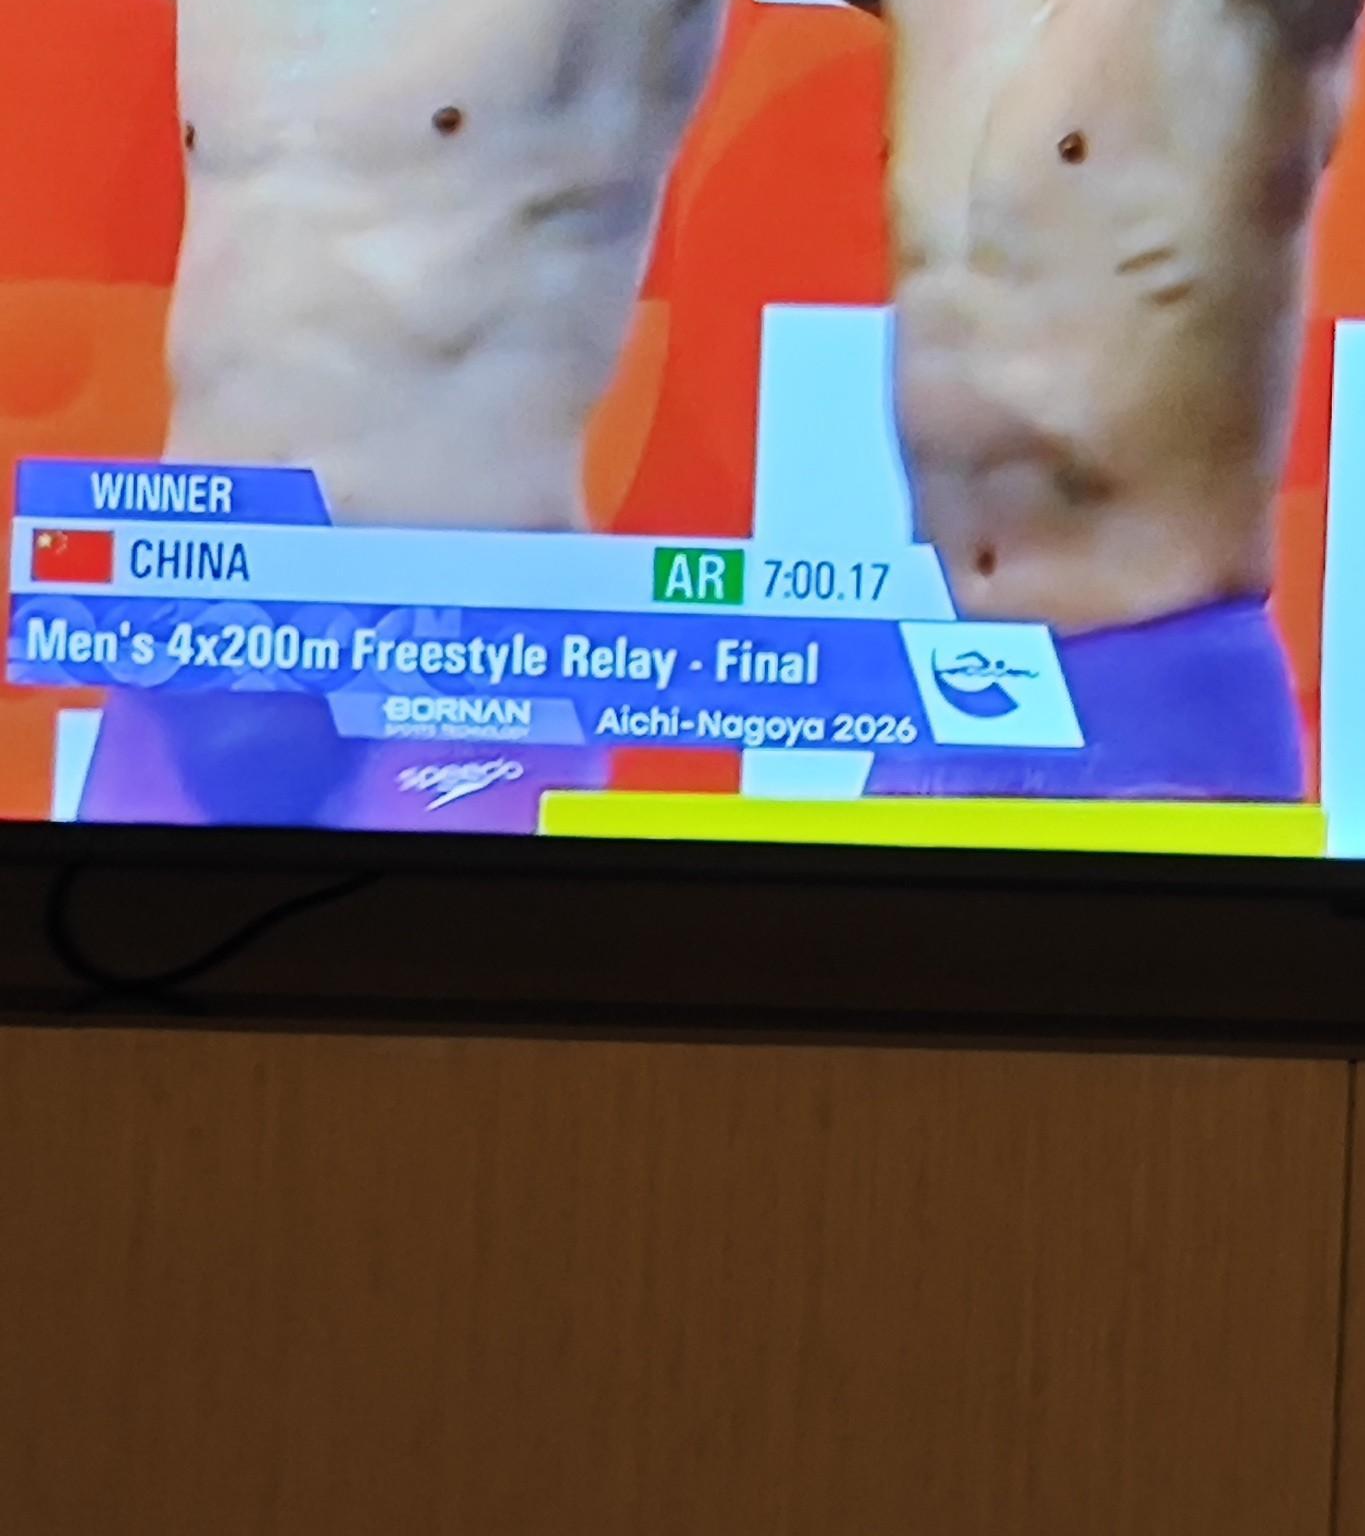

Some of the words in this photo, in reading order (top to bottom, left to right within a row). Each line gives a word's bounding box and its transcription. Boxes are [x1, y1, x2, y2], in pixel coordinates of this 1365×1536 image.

[90, 471, 233, 514] WINNER
[130, 539, 251, 583] CHINA
[664, 553, 727, 600] AR
[764, 560, 890, 602] 7:00.17
[26, 618, 155, 666] Men's
[167, 624, 341, 671] 4x200m
[351, 629, 548, 685] Freestyle
[562, 635, 677, 690] Relay
[716, 642, 819, 686] Final
[383, 695, 532, 725] BORNAN
[596, 707, 826, 748] Aichi-Nagoya
[833, 713, 918, 745] 2026
